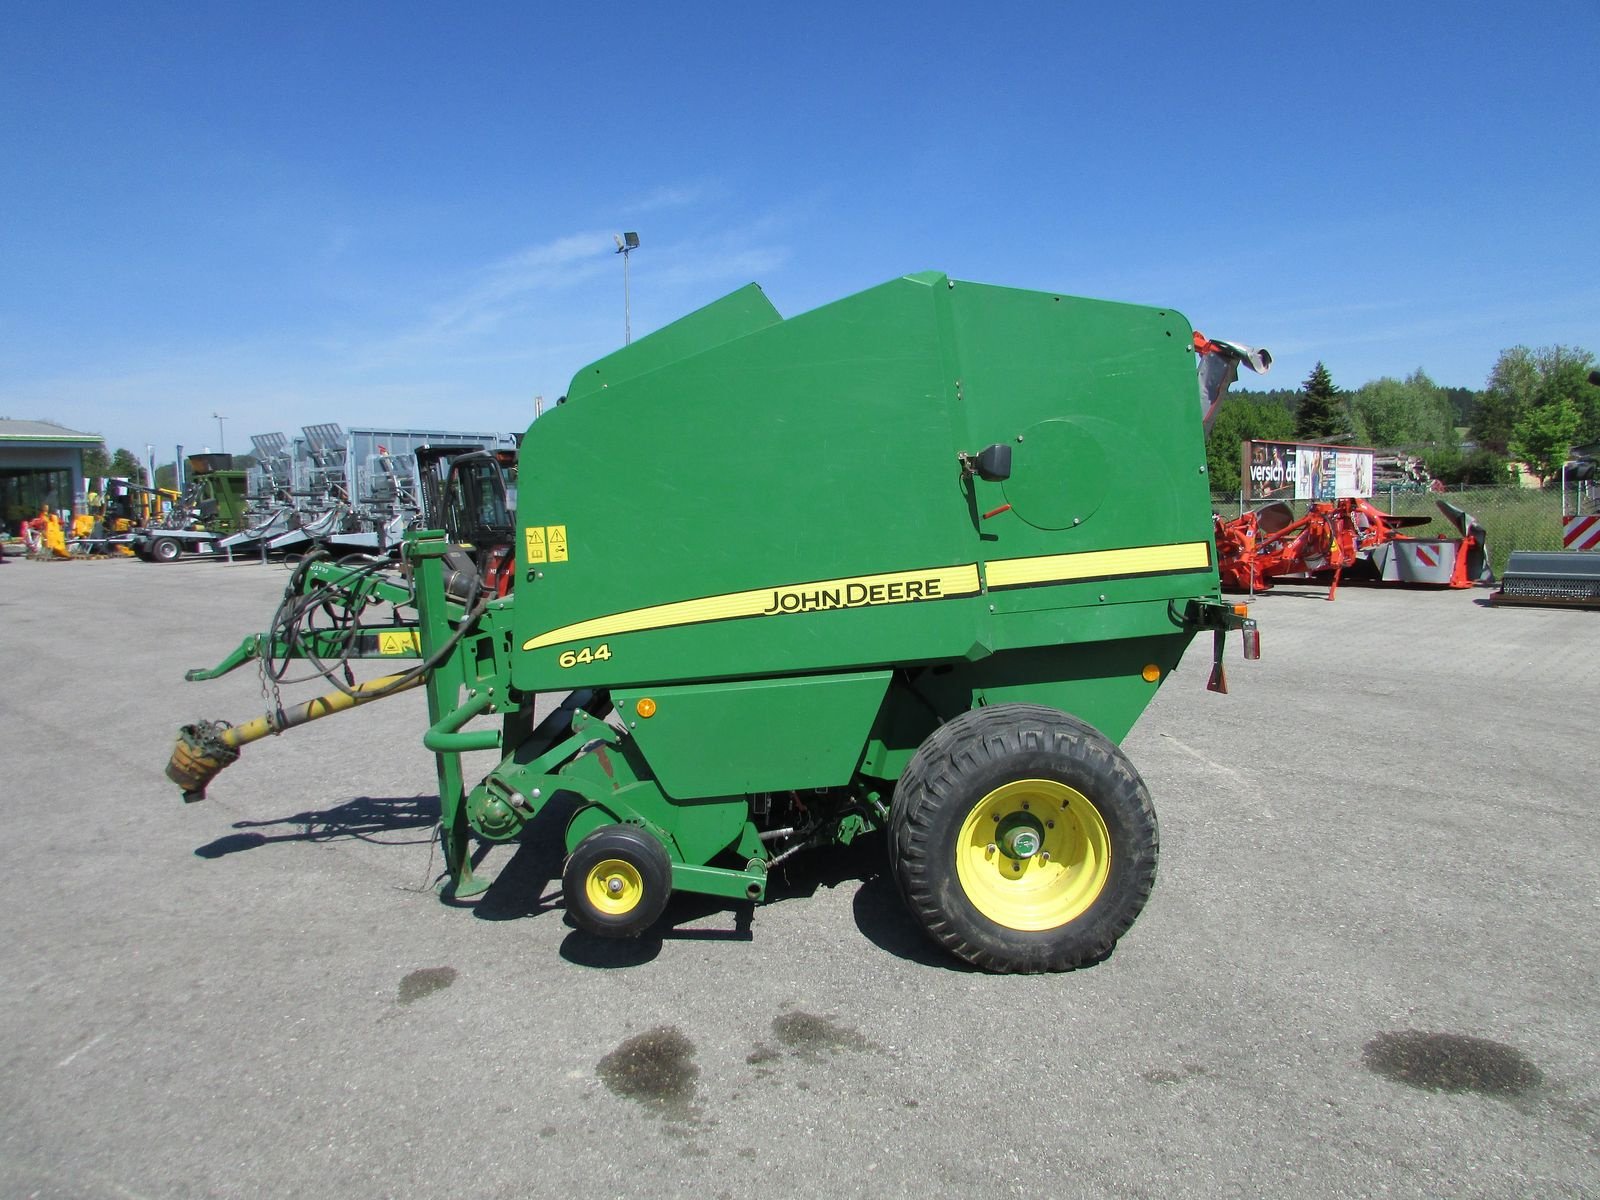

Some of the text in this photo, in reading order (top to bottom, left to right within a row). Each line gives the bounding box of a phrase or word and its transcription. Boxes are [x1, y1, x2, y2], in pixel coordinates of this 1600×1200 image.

[764, 578, 941, 613] JOHN DEERE
[559, 643, 612, 668] 644
